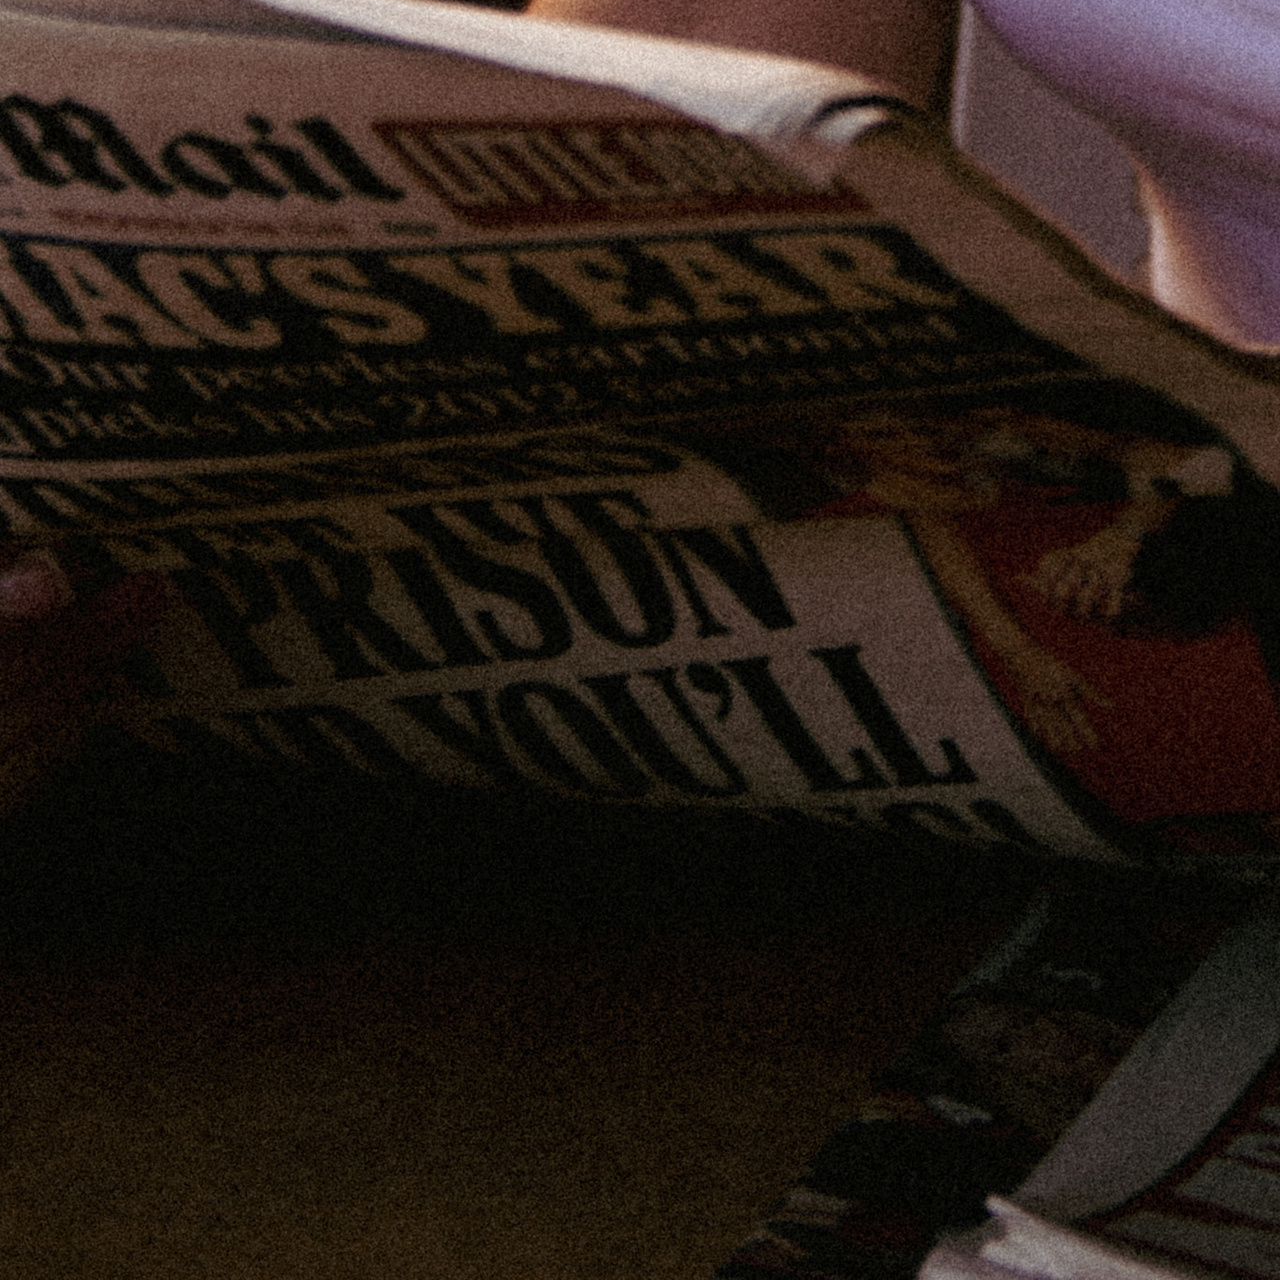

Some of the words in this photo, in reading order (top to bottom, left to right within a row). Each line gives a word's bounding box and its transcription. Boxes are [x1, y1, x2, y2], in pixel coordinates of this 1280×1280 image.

[0, 94, 406, 203] Mail
[385, 126, 800, 208] LITTLEJO
[386, 232, 966, 342] YEAR
[184, 490, 797, 690] PRISON
[390, 643, 980, 801] YOU'LL
